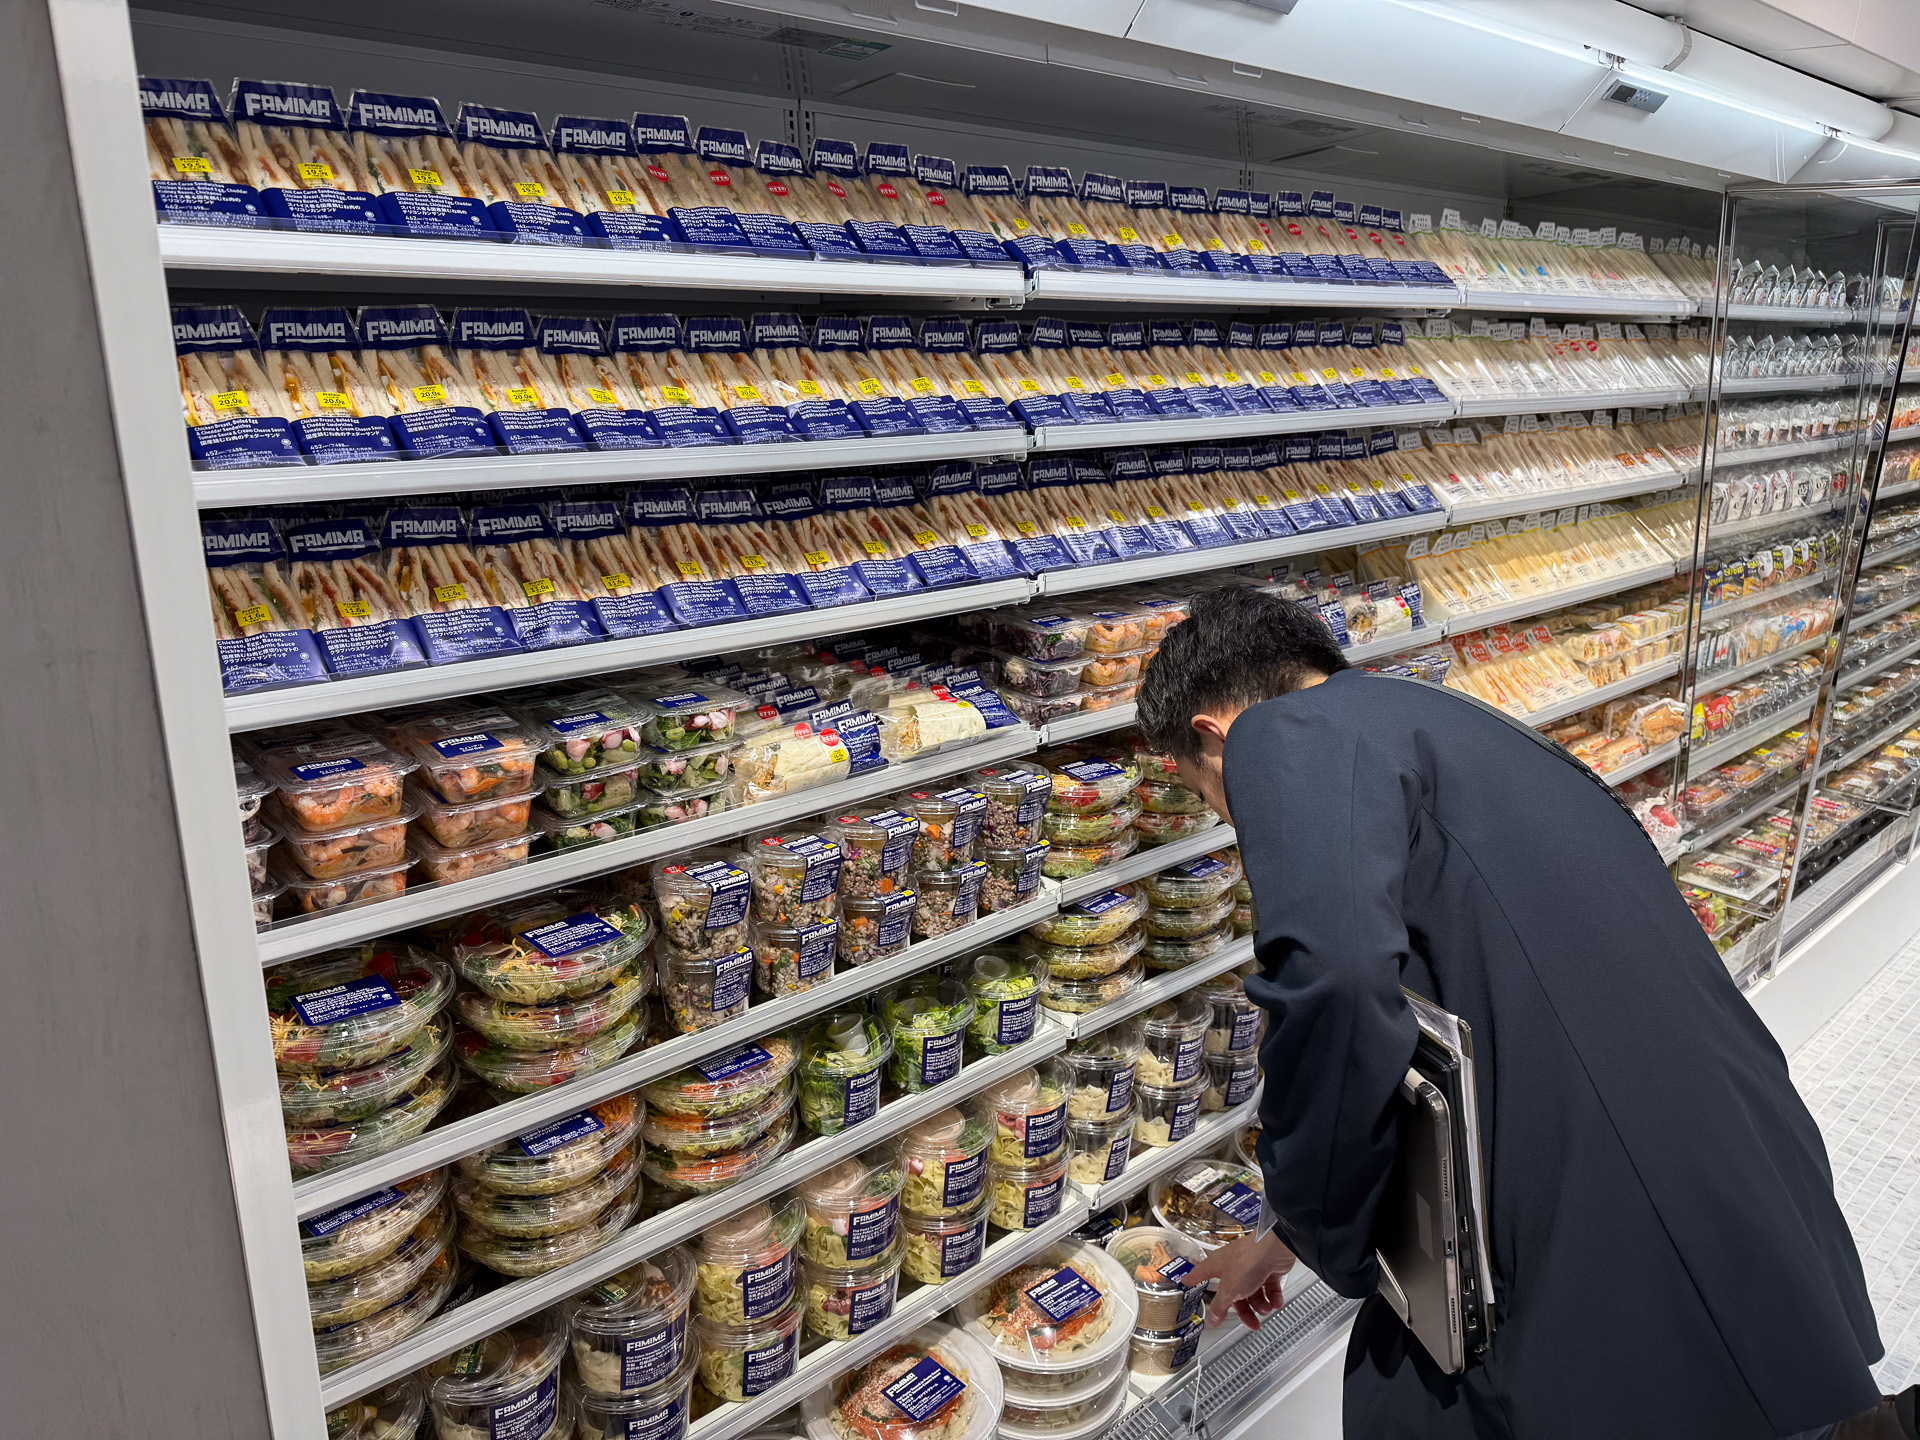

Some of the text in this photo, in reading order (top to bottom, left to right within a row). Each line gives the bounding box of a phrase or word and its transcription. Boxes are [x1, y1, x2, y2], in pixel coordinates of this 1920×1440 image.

[139, 91, 210, 111] AMIMA
[244, 92, 331, 117] FAMIMA
[358, 103, 436, 126] FAMIMA
[466, 116, 536, 138] FAMIMA
[637, 127, 685, 144] FAMIMA
[561, 128, 627, 148] FAMIMA
[700, 140, 745, 156] FAMIMA
[760, 153, 803, 170] FAMIMA
[814, 150, 854, 166] FAMIMA
[869, 153, 907, 169] FAMIMA
[917, 166, 953, 182] FAMIMA
[969, 174, 1010, 189] FAMIMA
[1029, 175, 1069, 191] FAMIMA
[1085, 181, 1122, 199] FAMIMA
[1127, 190, 1164, 206] FAMIMA
[173, 322, 241, 339] AMIMA
[270, 322, 346, 344] FAMIMA
[365, 319, 436, 342] FAMIMA
[461, 321, 525, 341] FAMIMA
[543, 329, 600, 348] FAMIMA
[618, 327, 676, 346] FAMIMA
[690, 330, 741, 348] FAMIMA
[755, 325, 799, 342] FAMIMA
[818, 328, 859, 345] FAMIMA
[872, 326, 912, 343] FAMIMA
[925, 331, 964, 347] FAMIMA
[981, 333, 1018, 349] FAMIMA
[932, 470, 972, 490] FAMIMA
[980, 473, 1017, 489] FAMIMA
[826, 487, 871, 504] FAMIMA
[634, 500, 687, 519] FAMIMA
[700, 501, 751, 519] FAMIMA
[763, 497, 812, 515] FAMIMA
[391, 519, 457, 540] FAMIMA
[479, 515, 542, 536] FAMIMA
[557, 513, 614, 532] FAMIMA
[201, 532, 270, 550] AMIMA
[290, 529, 366, 552] FAMIMA
[655, 691, 696, 705] FAMIMA
[776, 689, 816, 708] FAMIMA
[551, 713, 599, 727] FAMIMA
[812, 702, 851, 725] FAMIMA
[837, 713, 877, 734] FAMIMA
[437, 733, 488, 749] FAMIMA
[297, 758, 354, 773] FAMIMA
[711, 872, 749, 892] FAMIMA
[524, 921, 568, 938] FAMIMA
[801, 922, 838, 946] FAMIMA
[716, 951, 753, 976] FAMIMA
[295, 985, 347, 1002] FAMIMA
[747, 1261, 783, 1284] FAMIMA
[626, 1330, 667, 1353] FAMIMA
[748, 1343, 784, 1363] FAMIMA
[494, 1390, 538, 1420] FAMIMA
[629, 1408, 668, 1431] FAMIMA
